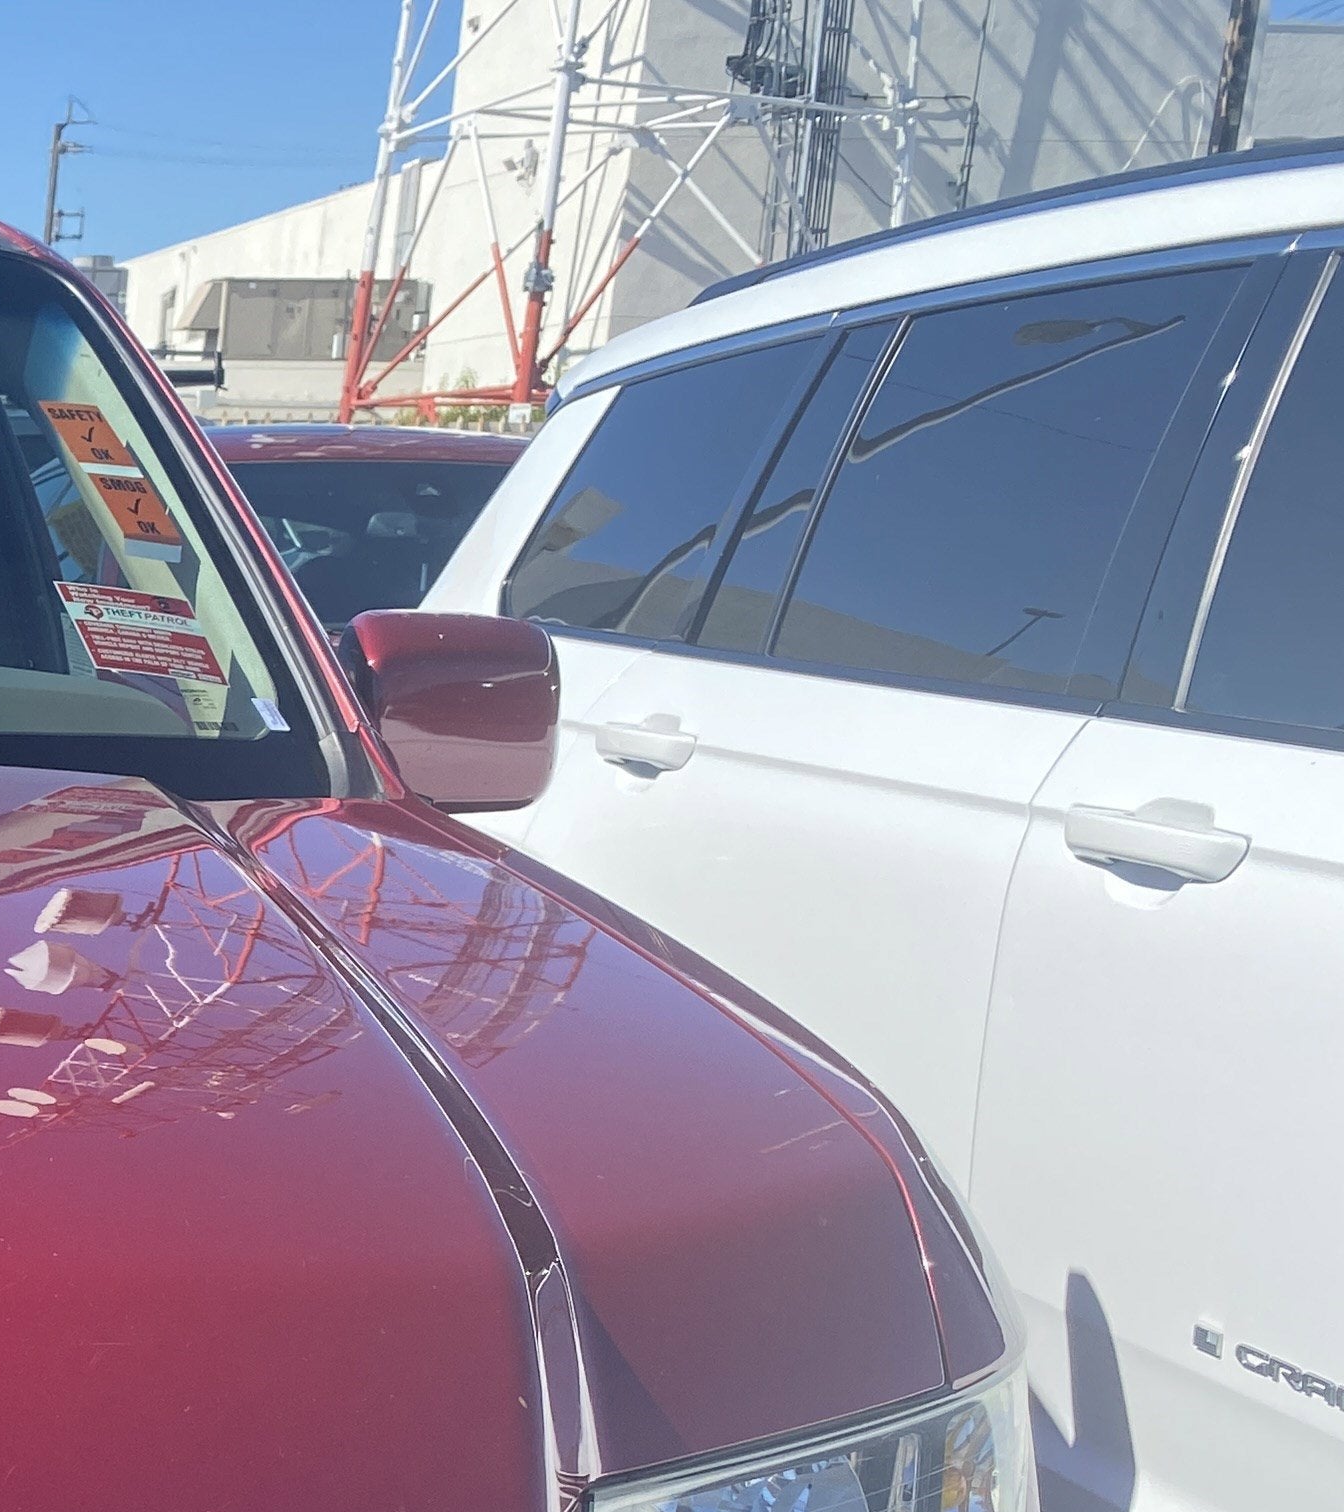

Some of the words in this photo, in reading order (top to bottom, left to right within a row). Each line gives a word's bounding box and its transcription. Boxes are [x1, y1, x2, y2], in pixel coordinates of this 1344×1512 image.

[47, 408, 104, 422] SAFETY
[90, 447, 115, 460] OK
[98, 477, 148, 494] SMOG
[136, 520, 162, 535] OK
